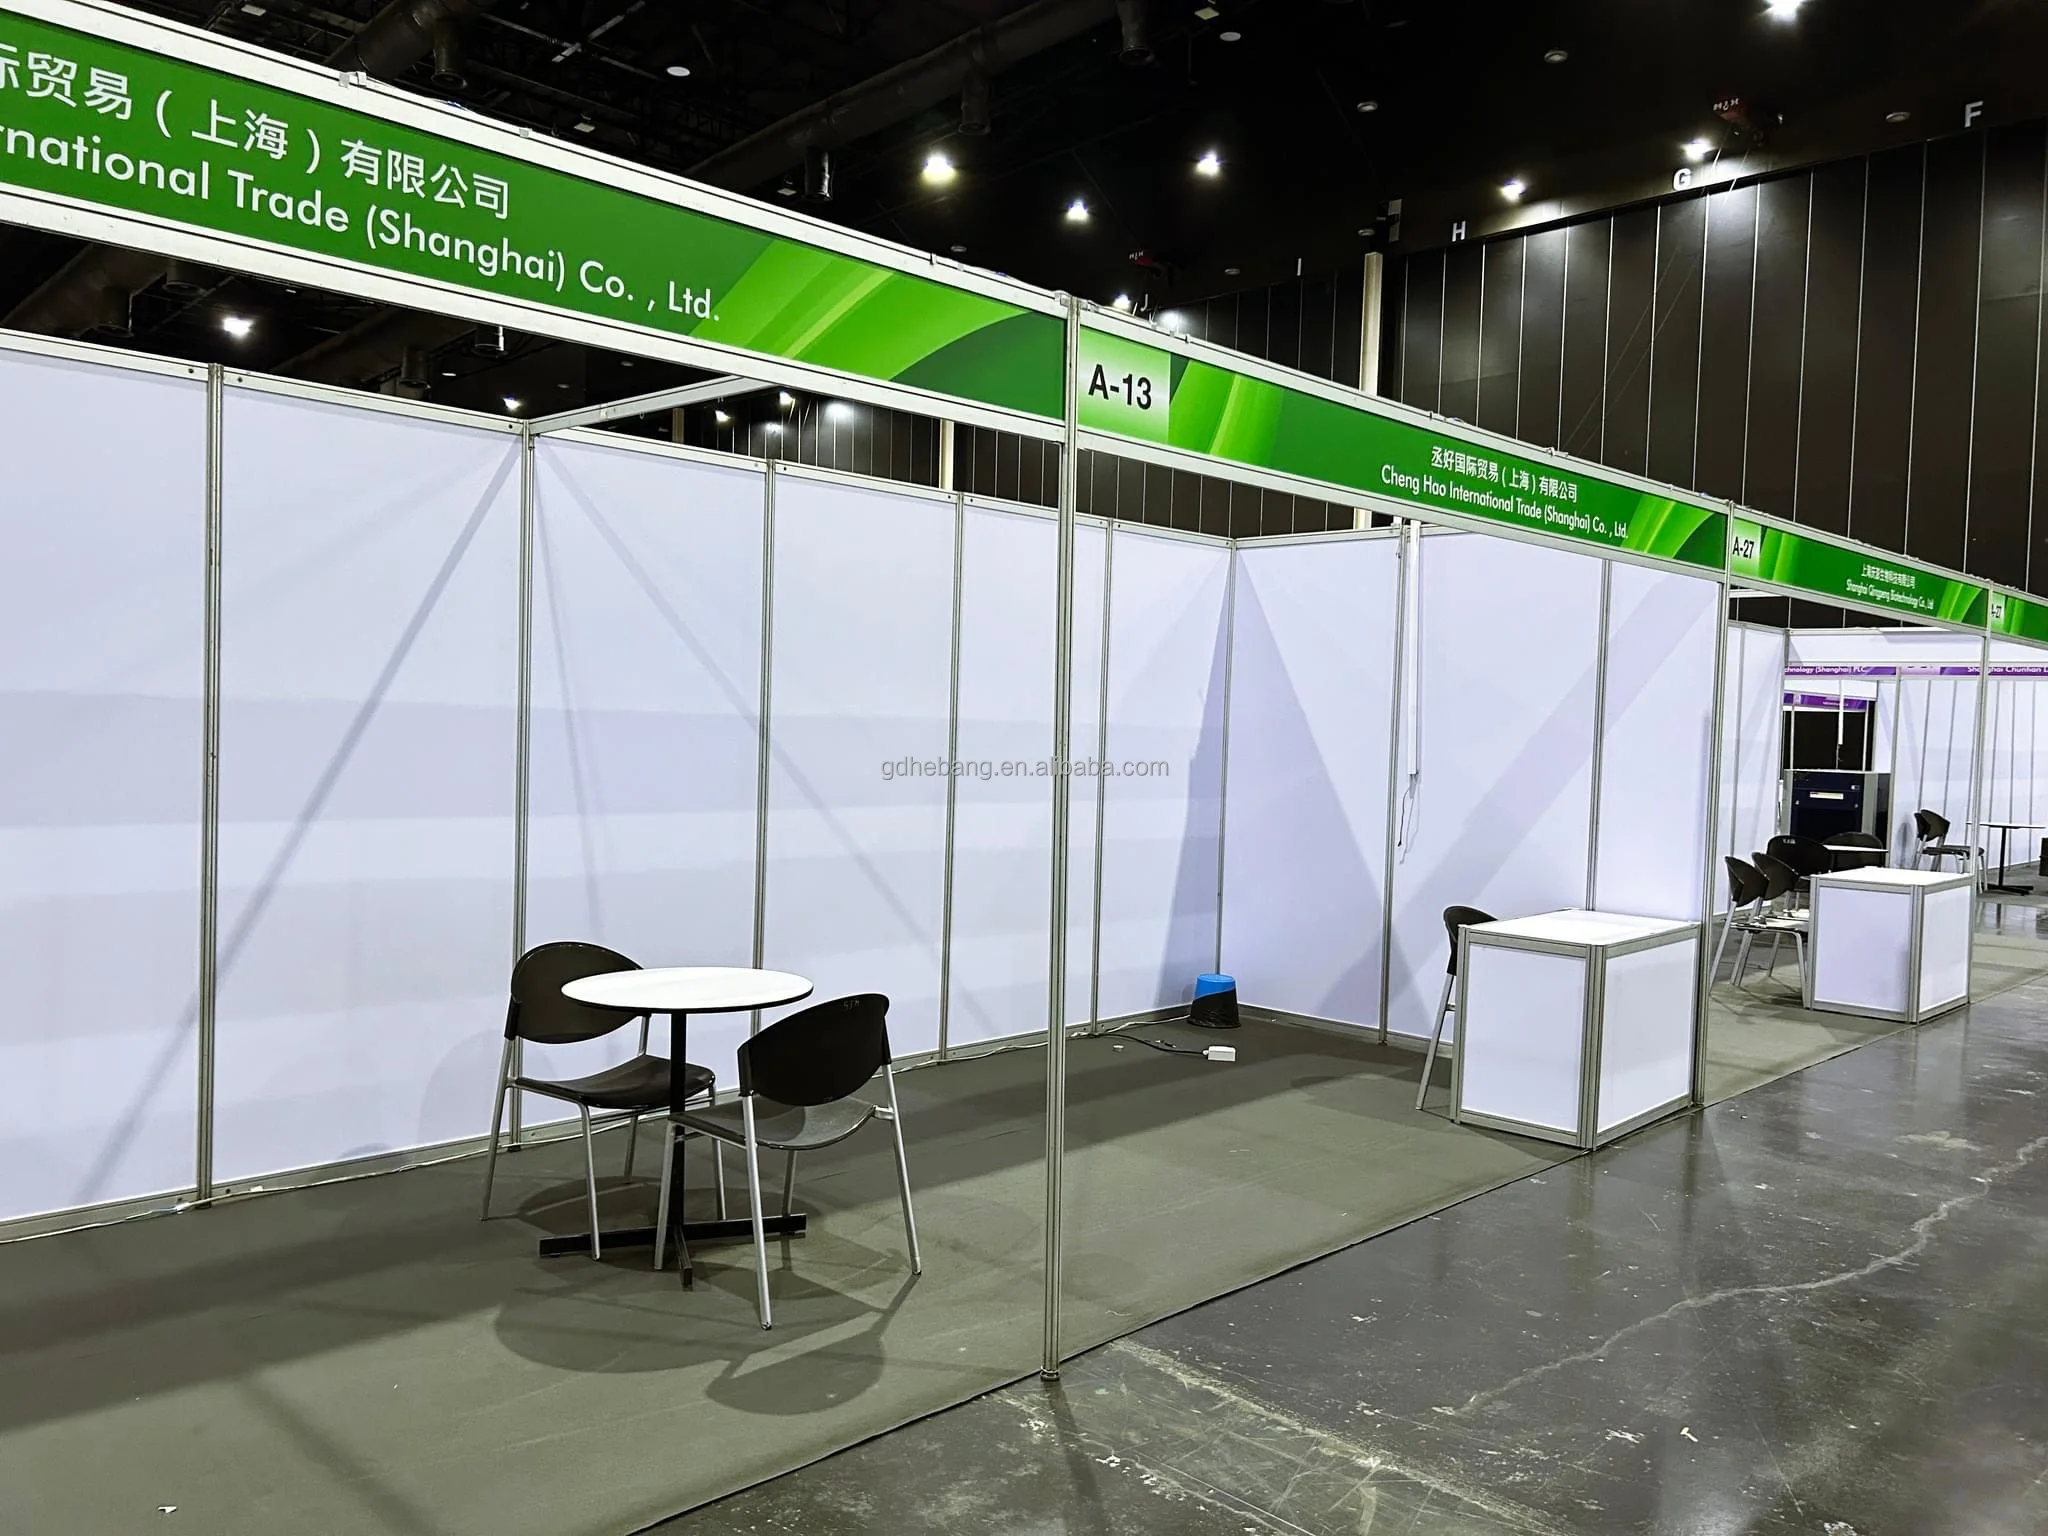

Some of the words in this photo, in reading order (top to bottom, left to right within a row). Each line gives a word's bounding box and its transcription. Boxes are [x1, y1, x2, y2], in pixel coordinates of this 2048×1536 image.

[1964, 100, 1984, 128] F
[1672, 168, 1692, 191] G
[228, 169, 349, 232] Trade
[367, 204, 565, 292] (Shanghai)
[579, 261, 634, 301] Co.
[668, 280, 720, 321] Ltd.
[1451, 221, 1466, 242] H
[1088, 363, 1151, 410] A-13
[1381, 464, 1420, 495] Cheng
[1423, 475, 1446, 496] Hao
[1449, 481, 1513, 513] International
[1516, 498, 1541, 518] Trade
[1544, 505, 1590, 531] (Shanghai)
[1592, 516, 1607, 534] Co.
[1614, 521, 1629, 539] Ltd.
[1732, 536, 1754, 559] A-27
